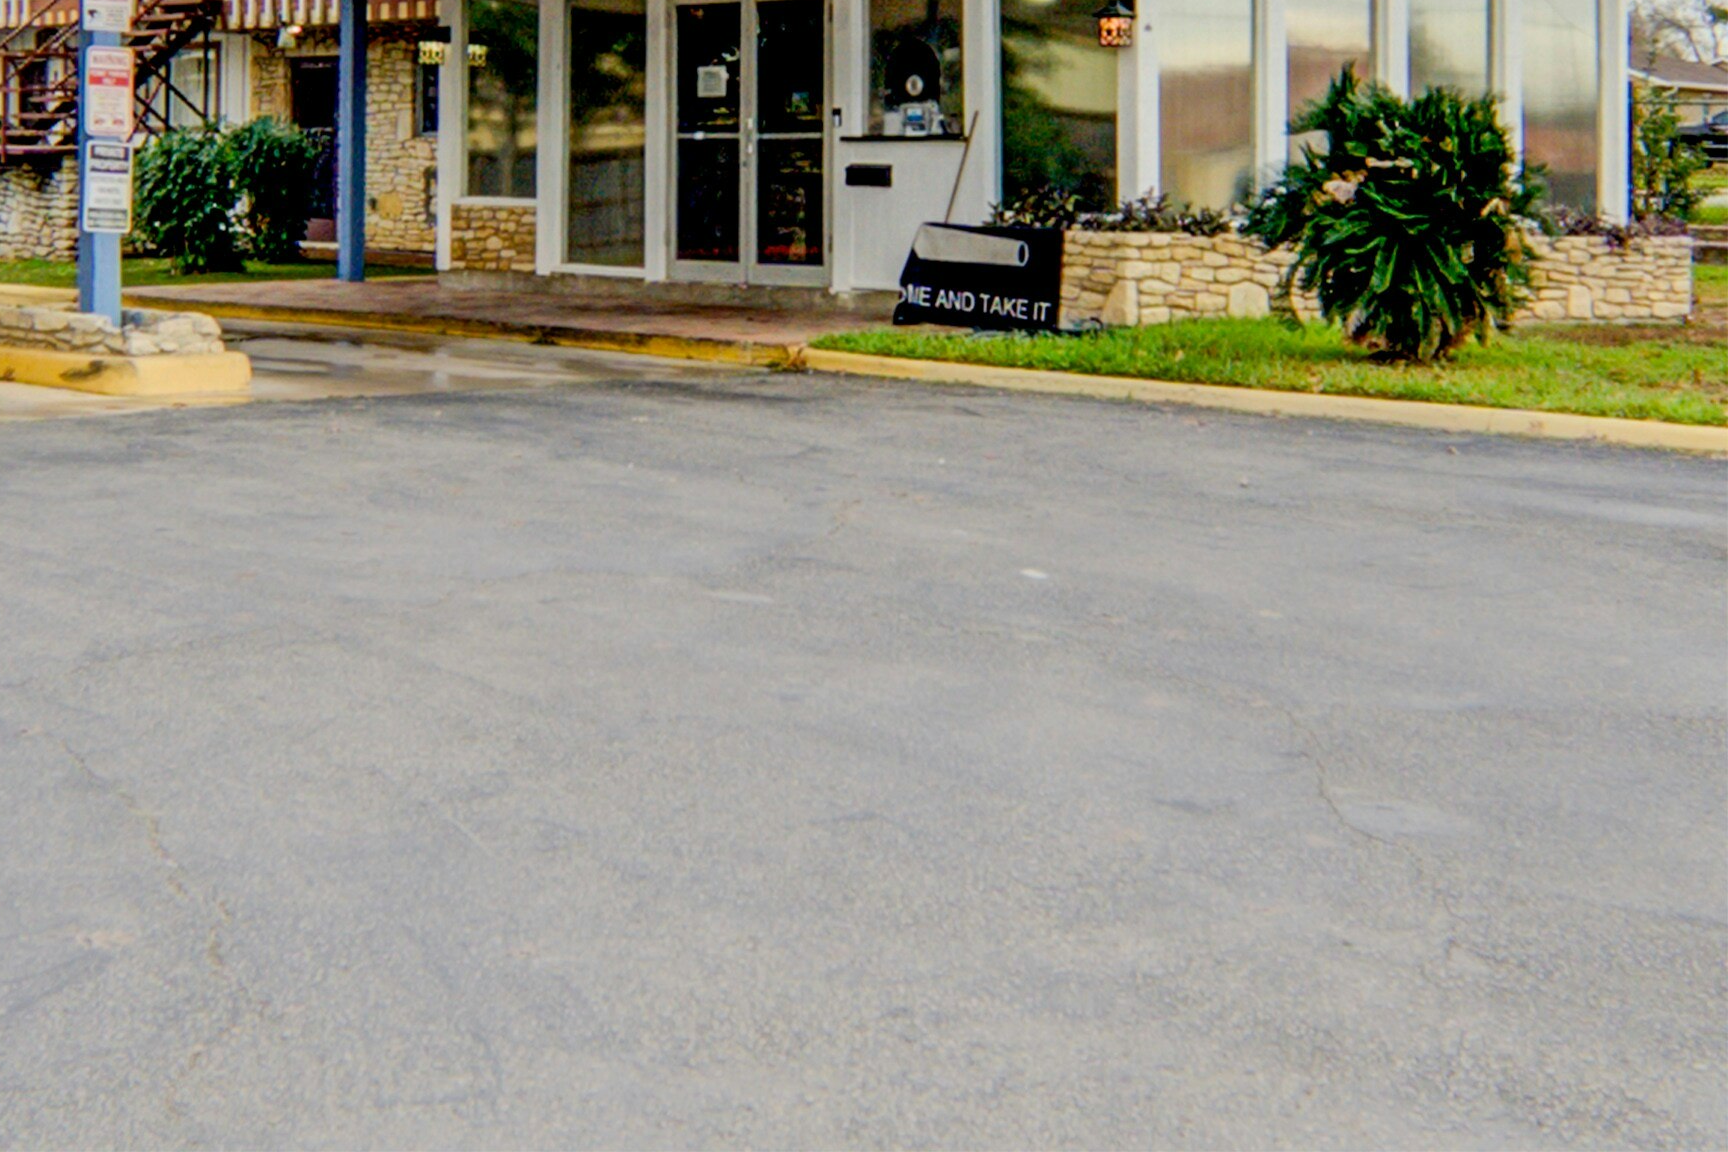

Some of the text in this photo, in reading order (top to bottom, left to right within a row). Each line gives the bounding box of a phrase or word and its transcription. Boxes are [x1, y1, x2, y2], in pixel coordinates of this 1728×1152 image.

[935, 288, 975, 312] AND
[979, 293, 1028, 320] TAKE
[1032, 301, 1051, 322] IT
